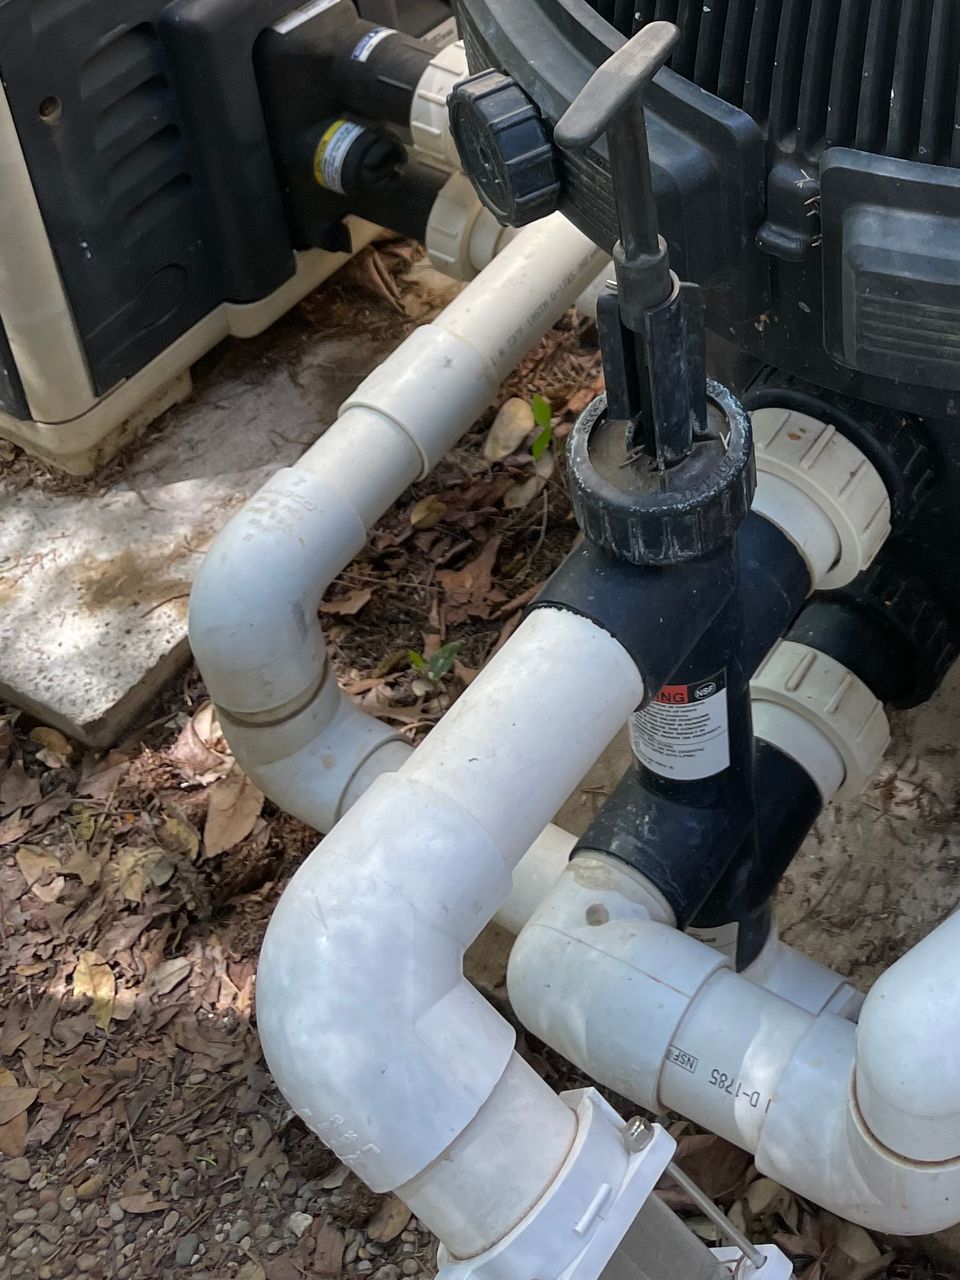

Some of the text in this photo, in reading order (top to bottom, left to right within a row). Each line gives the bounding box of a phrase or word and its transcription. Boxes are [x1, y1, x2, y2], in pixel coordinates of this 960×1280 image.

[695, 683, 715, 697] NSF
[672, 1050, 760, 1108] D-1785 NSF
